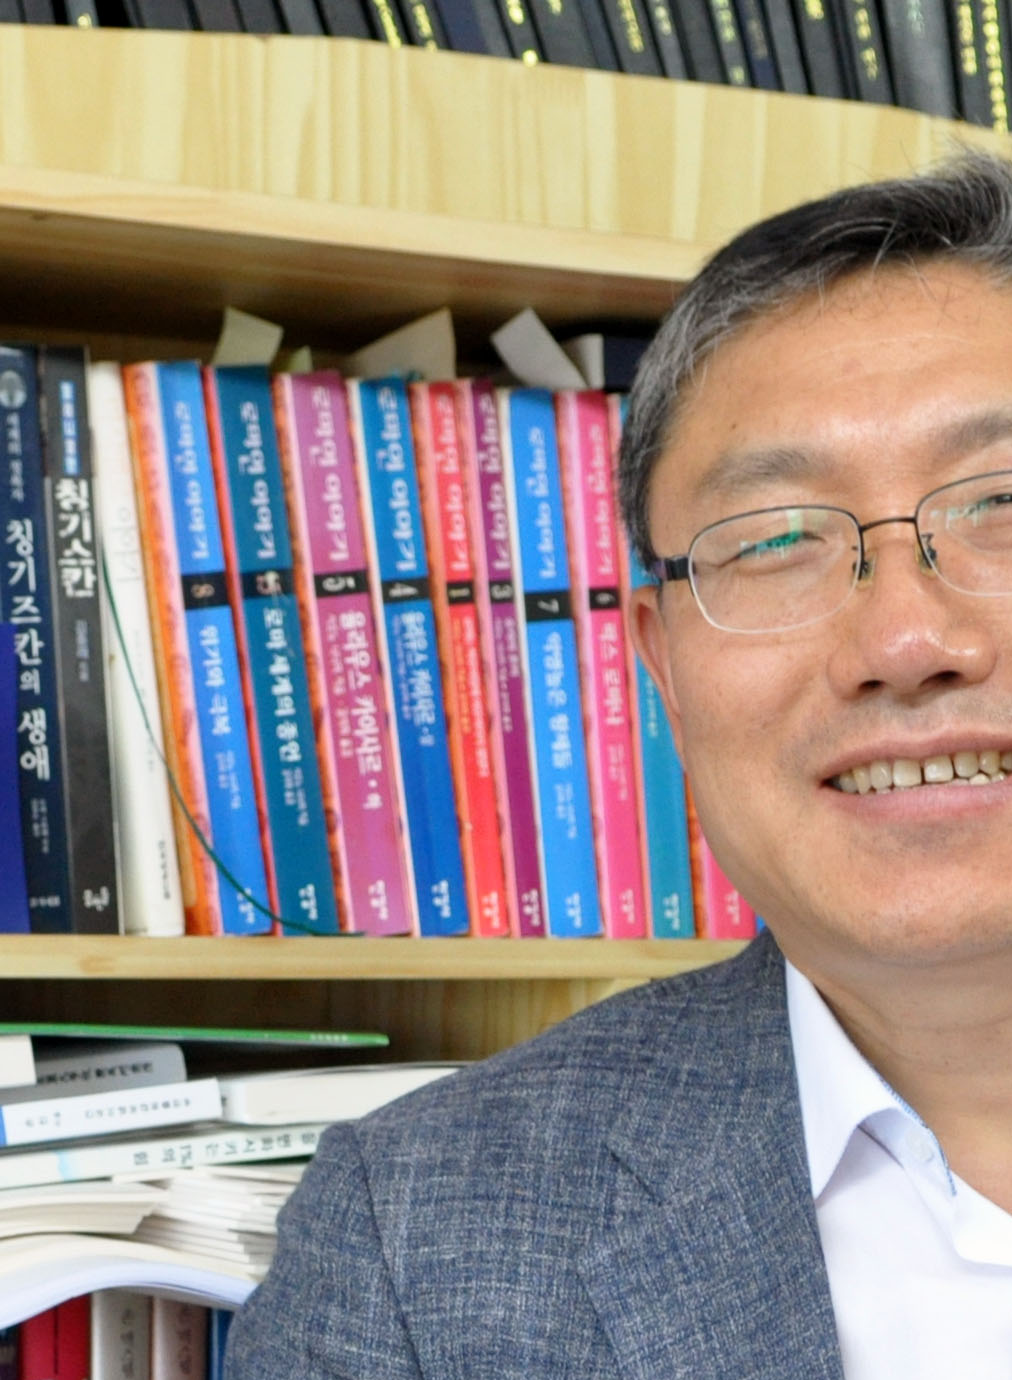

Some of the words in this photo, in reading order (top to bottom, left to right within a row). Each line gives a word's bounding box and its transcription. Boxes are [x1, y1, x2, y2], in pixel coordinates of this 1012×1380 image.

[238, 401, 266, 475] 로마인
[376, 387, 405, 472] 로마인
[478, 393, 502, 474] 로마인
[527, 426, 551, 498] 로마인
[310, 386, 338, 468] 로마인
[325, 474, 350, 562] 이야기
[436, 393, 458, 474] 로마인
[448, 483, 470, 572] 이야기
[55, 477, 97, 598] 칭기스칸
[187, 479, 210, 560] 이야기
[251, 479, 276, 560] 이야기
[389, 478, 416, 572] 이야기
[488, 482, 511, 572] 이야기
[536, 501, 557, 580] 이야기
[595, 499, 613, 575] 이야기
[191, 583, 215, 600] 8
[322, 577, 355, 593] 5
[389, 583, 419, 599] 4
[449, 588, 467, 598] 1
[490, 585, 513, 600] 3
[538, 598, 560, 614] 7
[596, 592, 614, 605] 6
[263, 606, 288, 650] 로마
[269, 655, 296, 717] 세계의
[19, 708, 50, 780] 생애
[277, 720, 302, 763] 종언
[353, 695, 382, 776] 카이사르
